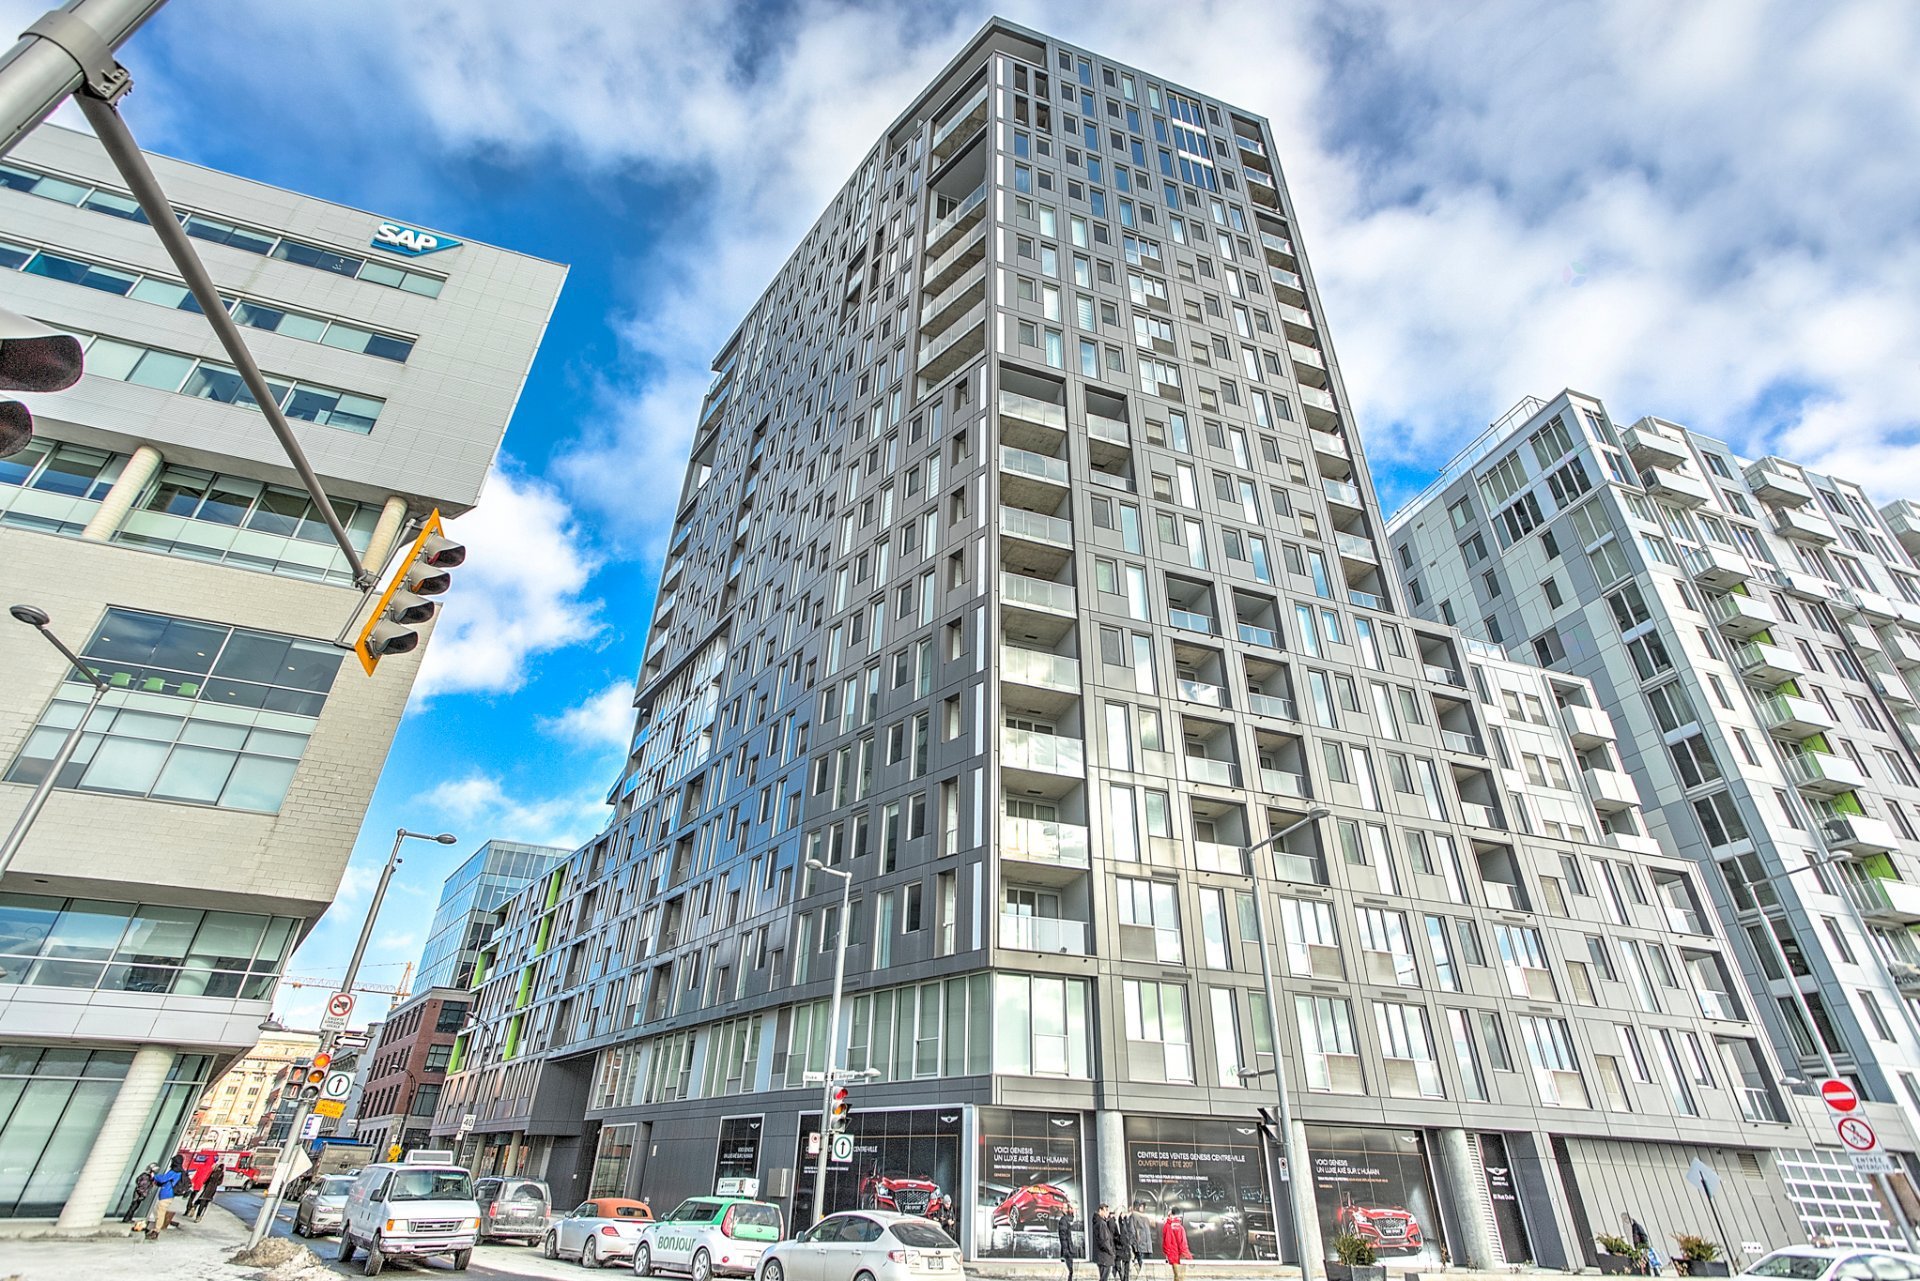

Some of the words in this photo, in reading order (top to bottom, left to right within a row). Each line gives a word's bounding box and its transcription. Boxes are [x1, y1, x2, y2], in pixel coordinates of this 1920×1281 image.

[374, 223, 438, 253] SAP
[463, 1118, 474, 1127] 40
[1010, 1147, 1033, 1155] GENESIS
[1003, 1155, 1018, 1163] LUXE
[1137, 1151, 1158, 1159] CENTRE
[1159, 1152, 1169, 1160] DES
[1170, 1152, 1190, 1160] VENTES
[1190, 1153, 1211, 1161] GENESIS
[1211, 1154, 1246, 1163] CENTRE-VILLE
[1137, 1160, 1169, 1168] OUVERTURE
[1182, 1161, 1194, 1169] 2017
